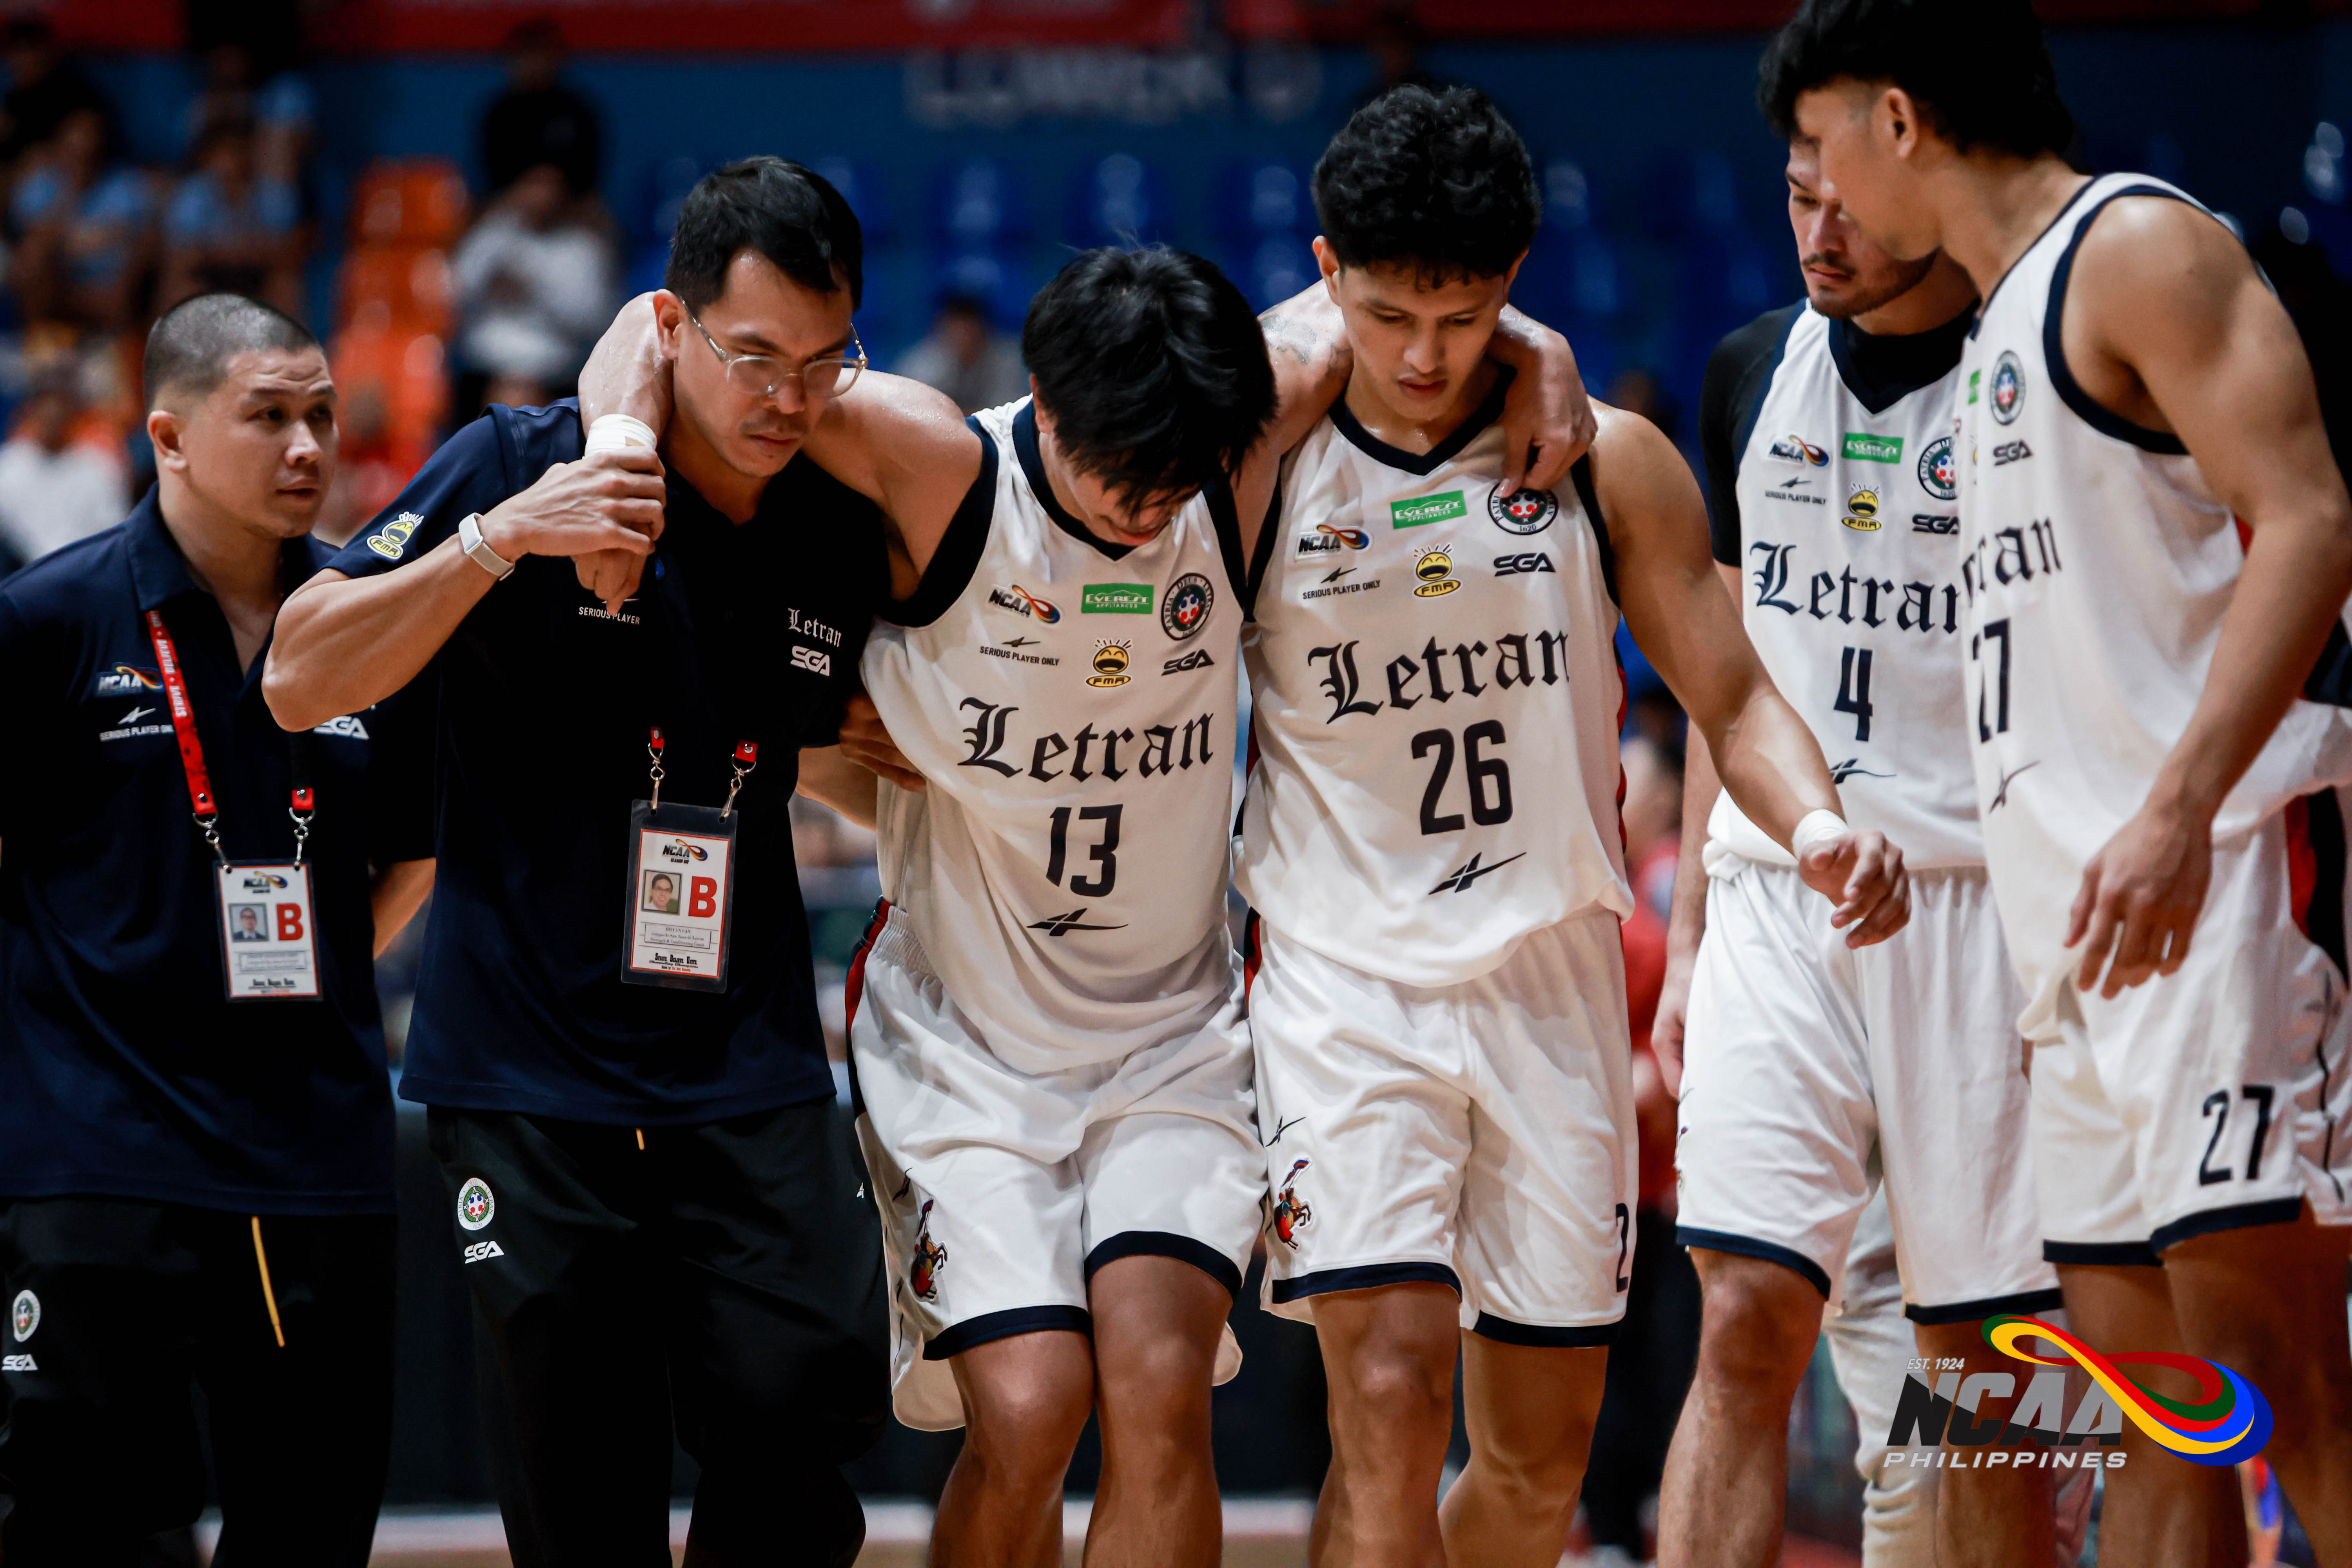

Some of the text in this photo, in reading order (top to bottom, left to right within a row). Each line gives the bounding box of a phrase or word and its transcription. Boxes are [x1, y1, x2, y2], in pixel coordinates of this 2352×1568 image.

[1993, 438, 2034, 466] SGA
[1395, 501, 1460, 519] EVEREST
[1408, 510, 1452, 522] APPLIANCES
[1492, 495, 1504, 521] PATR
[1849, 519, 1877, 528] FMA
[1912, 514, 1959, 535] SGA
[373, 540, 398, 555] FMA
[1299, 535, 1341, 552] NCAA
[1494, 552, 1556, 577] SGA
[1085, 593, 1149, 603] EVEREST
[1303, 579, 1381, 599] SERIOUS PLAYER ONLY
[1422, 581, 1454, 595] FMA
[579, 606, 611, 619] SERIOUS
[989, 589, 1032, 615] NCAA
[788, 608, 842, 647] Letran
[790, 645, 830, 676] SGA
[980, 646, 1060, 666] SERIOUS PLAYER ONLY
[1161, 649, 1215, 676] SGA
[1308, 630, 1569, 724] Letran
[1833, 646, 1873, 742] 4
[131, 725, 160, 736] PLAYER
[957, 697, 1214, 783] Letran
[1411, 719, 1514, 835] 26
[662, 845, 690, 857] NCAA
[1046, 803, 1123, 897] 13
[688, 876, 717, 918] B
[276, 902, 304, 941] B
[2199, 1083, 2275, 1187] 27
[464, 1240, 505, 1264] SGA
[1615, 1203, 1629, 1292] 2
[2, 1354, 38, 1371] SGA
